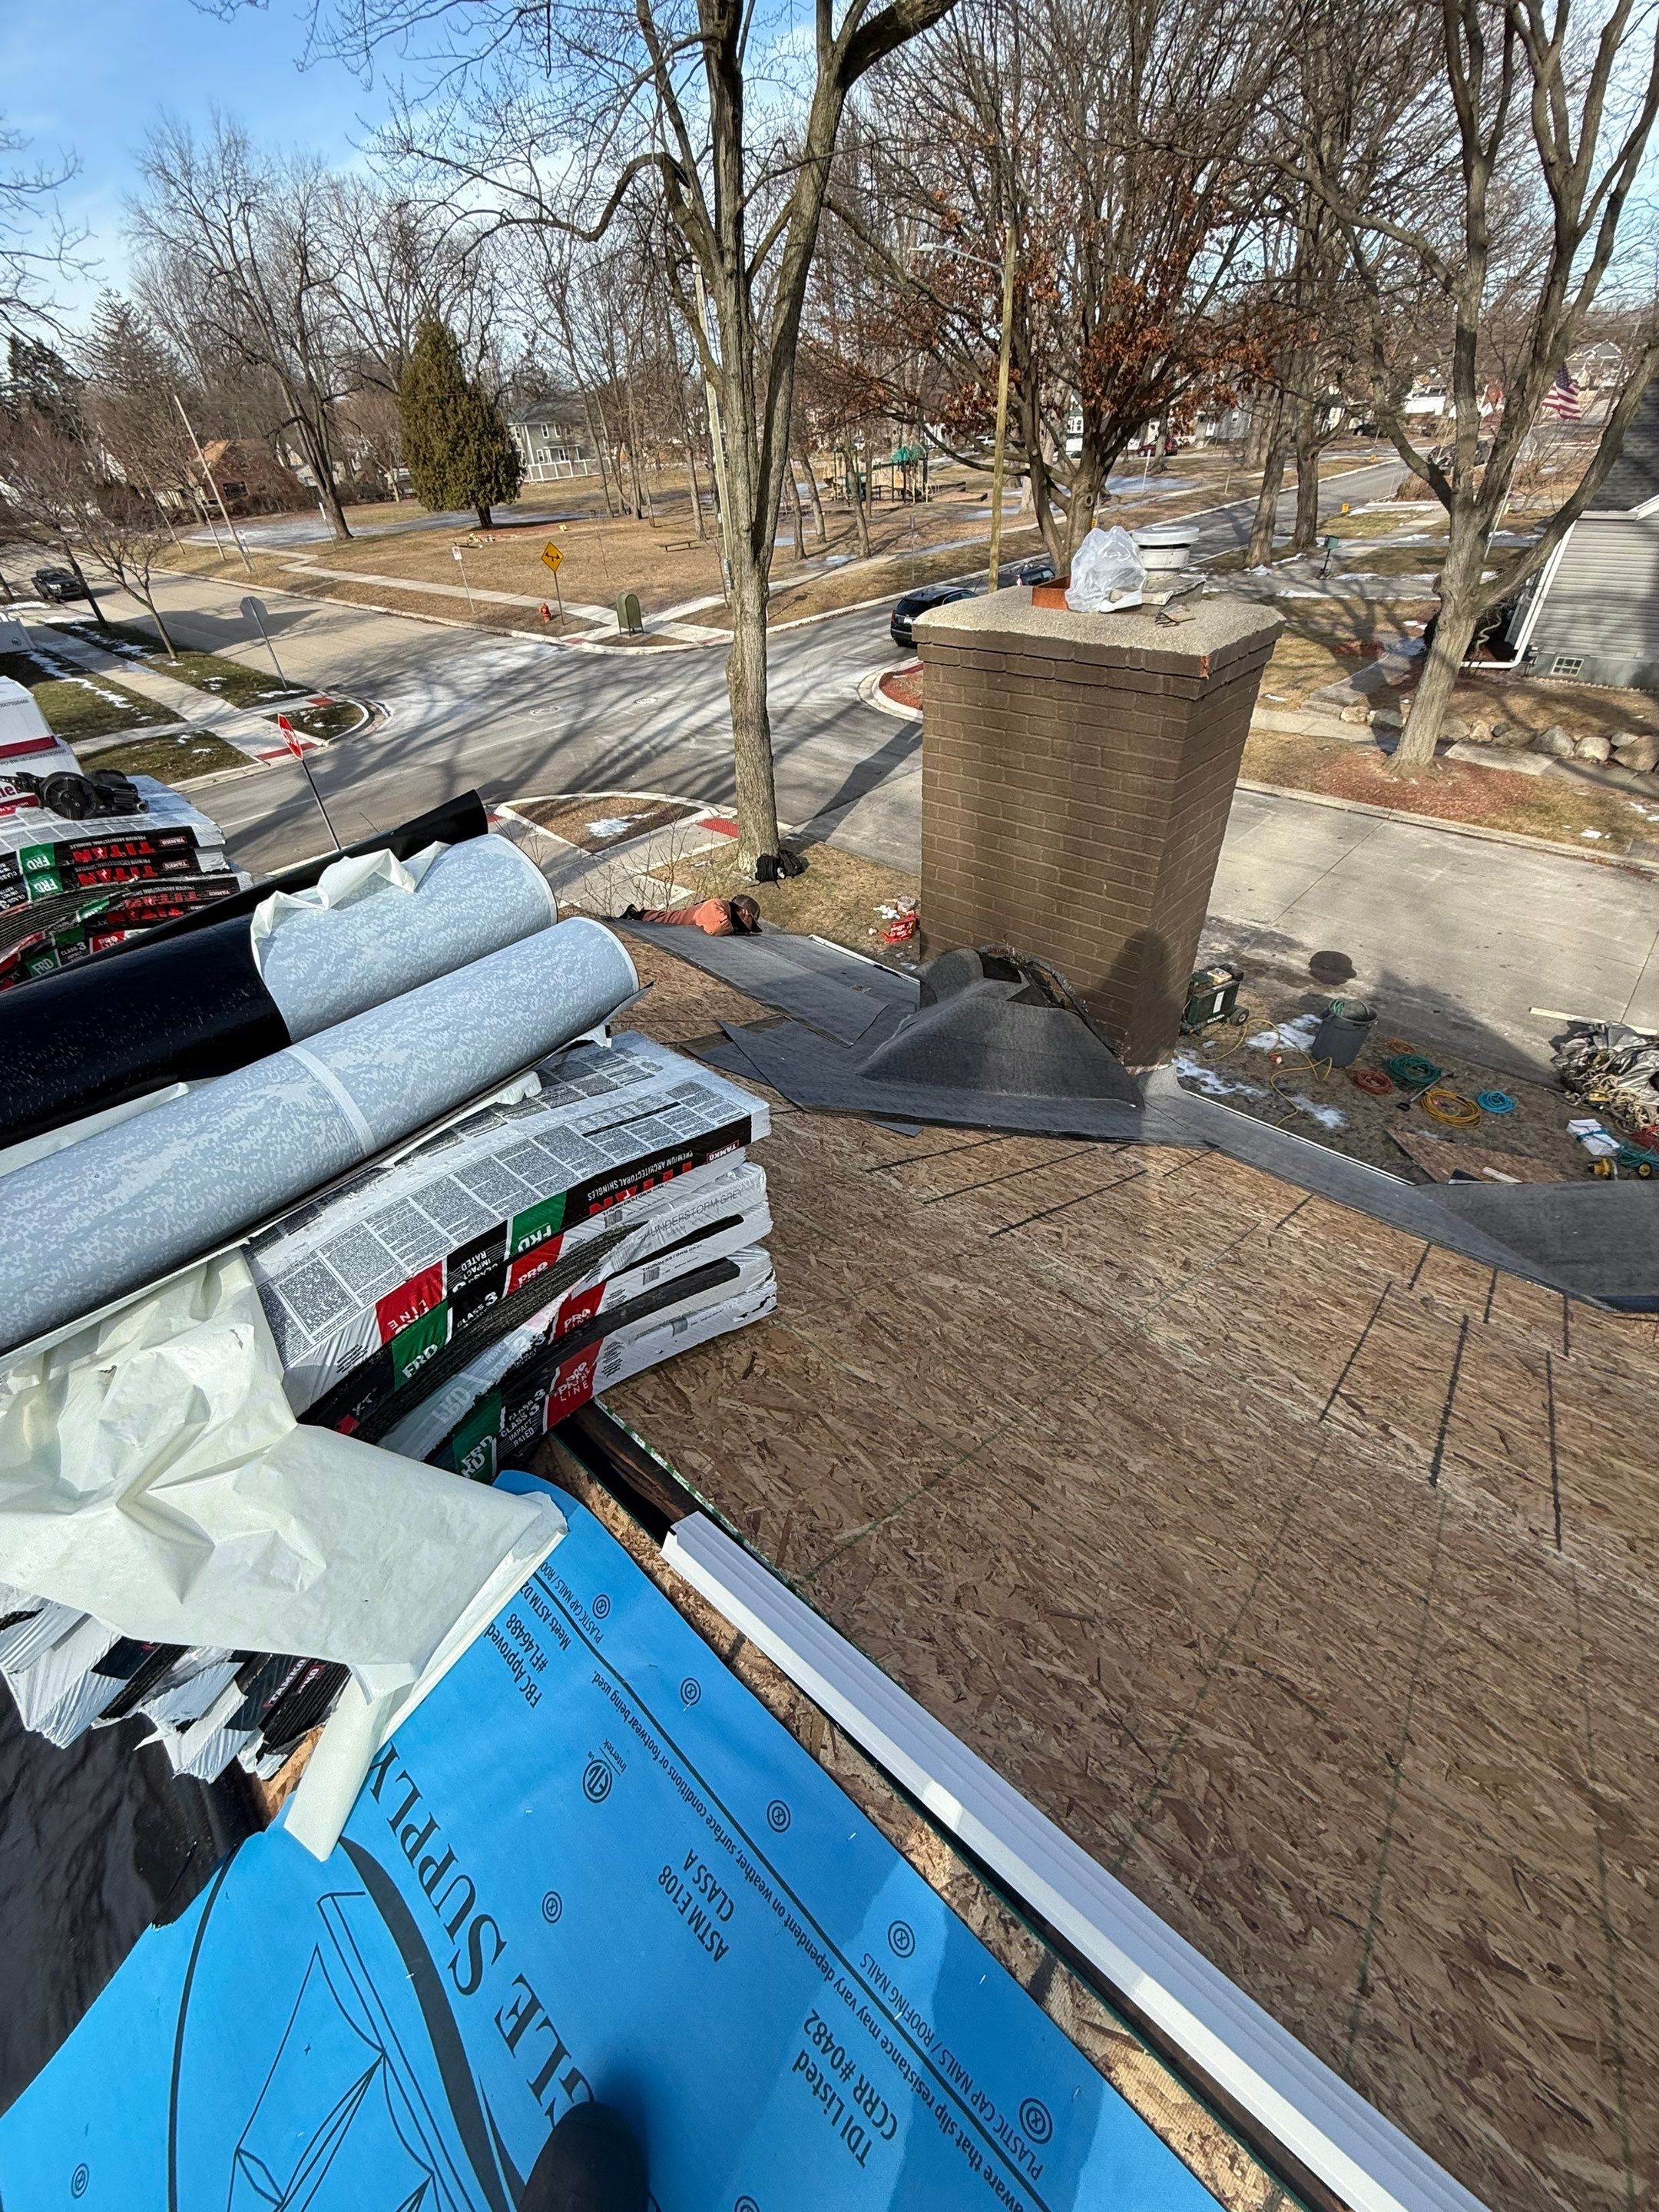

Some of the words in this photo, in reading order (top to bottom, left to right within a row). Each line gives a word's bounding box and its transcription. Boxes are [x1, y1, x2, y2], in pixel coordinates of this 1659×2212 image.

[72, 842, 155, 863] TITAN
[162, 836, 186, 845] TAMKO
[27, 855, 51, 870] FRD
[78, 866, 158, 886] TITAN
[164, 860, 189, 869] TAMKO
[34, 878, 58, 892] FRD
[77, 942, 87, 951] 3
[31, 959, 55, 975] FRD
[666, 1149, 694, 1167] PREMIUM
[708, 1144, 737, 1161] TAMKO
[587, 1180, 619, 1201] SHINGLES
[619, 1159, 666, 1190] ARCHITECTURAL
[461, 1250, 487, 1272] RATED
[463, 1257, 491, 1280] IMPACT
[518, 1260, 548, 1284] PRO
[386, 1299, 430, 1330] LINE
[457, 1304, 483, 1328] CLASS
[484, 1291, 498, 1306] 3
[564, 1308, 591, 1328] PRO
[402, 1343, 438, 1379] FRD
[535, 1387, 547, 1402] 3
[560, 1380, 589, 1402] LINE
[500, 1414, 528, 1439] CLASS
[513, 1427, 535, 1448] RATED
[539, 1561, 555, 1580] ROO
[555, 1579, 575, 1603] NAILS
[528, 1595, 551, 1622] ASTM
[569, 1599, 584, 1618] CAP
[505, 1613, 549, 1674] #FL46488
[549, 1618, 572, 1651] Meets
[578, 1611, 604, 1644] PLASTIC
[483, 1622, 527, 1684] Approved
[518, 1675, 543, 1709] FBC
[591, 1670, 612, 1697] used.
[609, 1690, 631, 1723] being
[628, 1715, 661, 1761] footwear
[603, 1737, 628, 1773] Intertek
[658, 1755, 670, 1770] or
[667, 1766, 707, 1817] conditions
[705, 1813, 737, 1855] surface
[369, 1742, 507, 1996] SUPPLY
[683, 1848, 699, 1872] A
[735, 1849, 773, 1903] weather,
[657, 1865, 694, 1916] E108
[691, 1863, 735, 1922] CLASS
[771, 1896, 786, 1919] on
[687, 1903, 730, 1963] ASTM
[783, 1913, 836, 1983] dependent
[859, 1952, 891, 1992] NAILS
[833, 1977, 858, 2012] vary
[856, 2005, 882, 2039] may
[888, 1985, 935, 2048] ROOFING
[803, 2008, 857, 2085] #0482
[791, 2048, 846, 2127] Listed
[879, 2035, 936, 2108] resistance
[938, 2048, 974, 2094] NAILS
[852, 2073, 898, 2141] CCRR
[934, 2101, 959, 2136] slip
[970, 2090, 996, 2122] CAP
[839, 2114, 873, 2170] TDI
[955, 2128, 984, 2172] that
[992, 2114, 1044, 2181] PLASTIC
[983, 2165, 1024, 2212] aware
